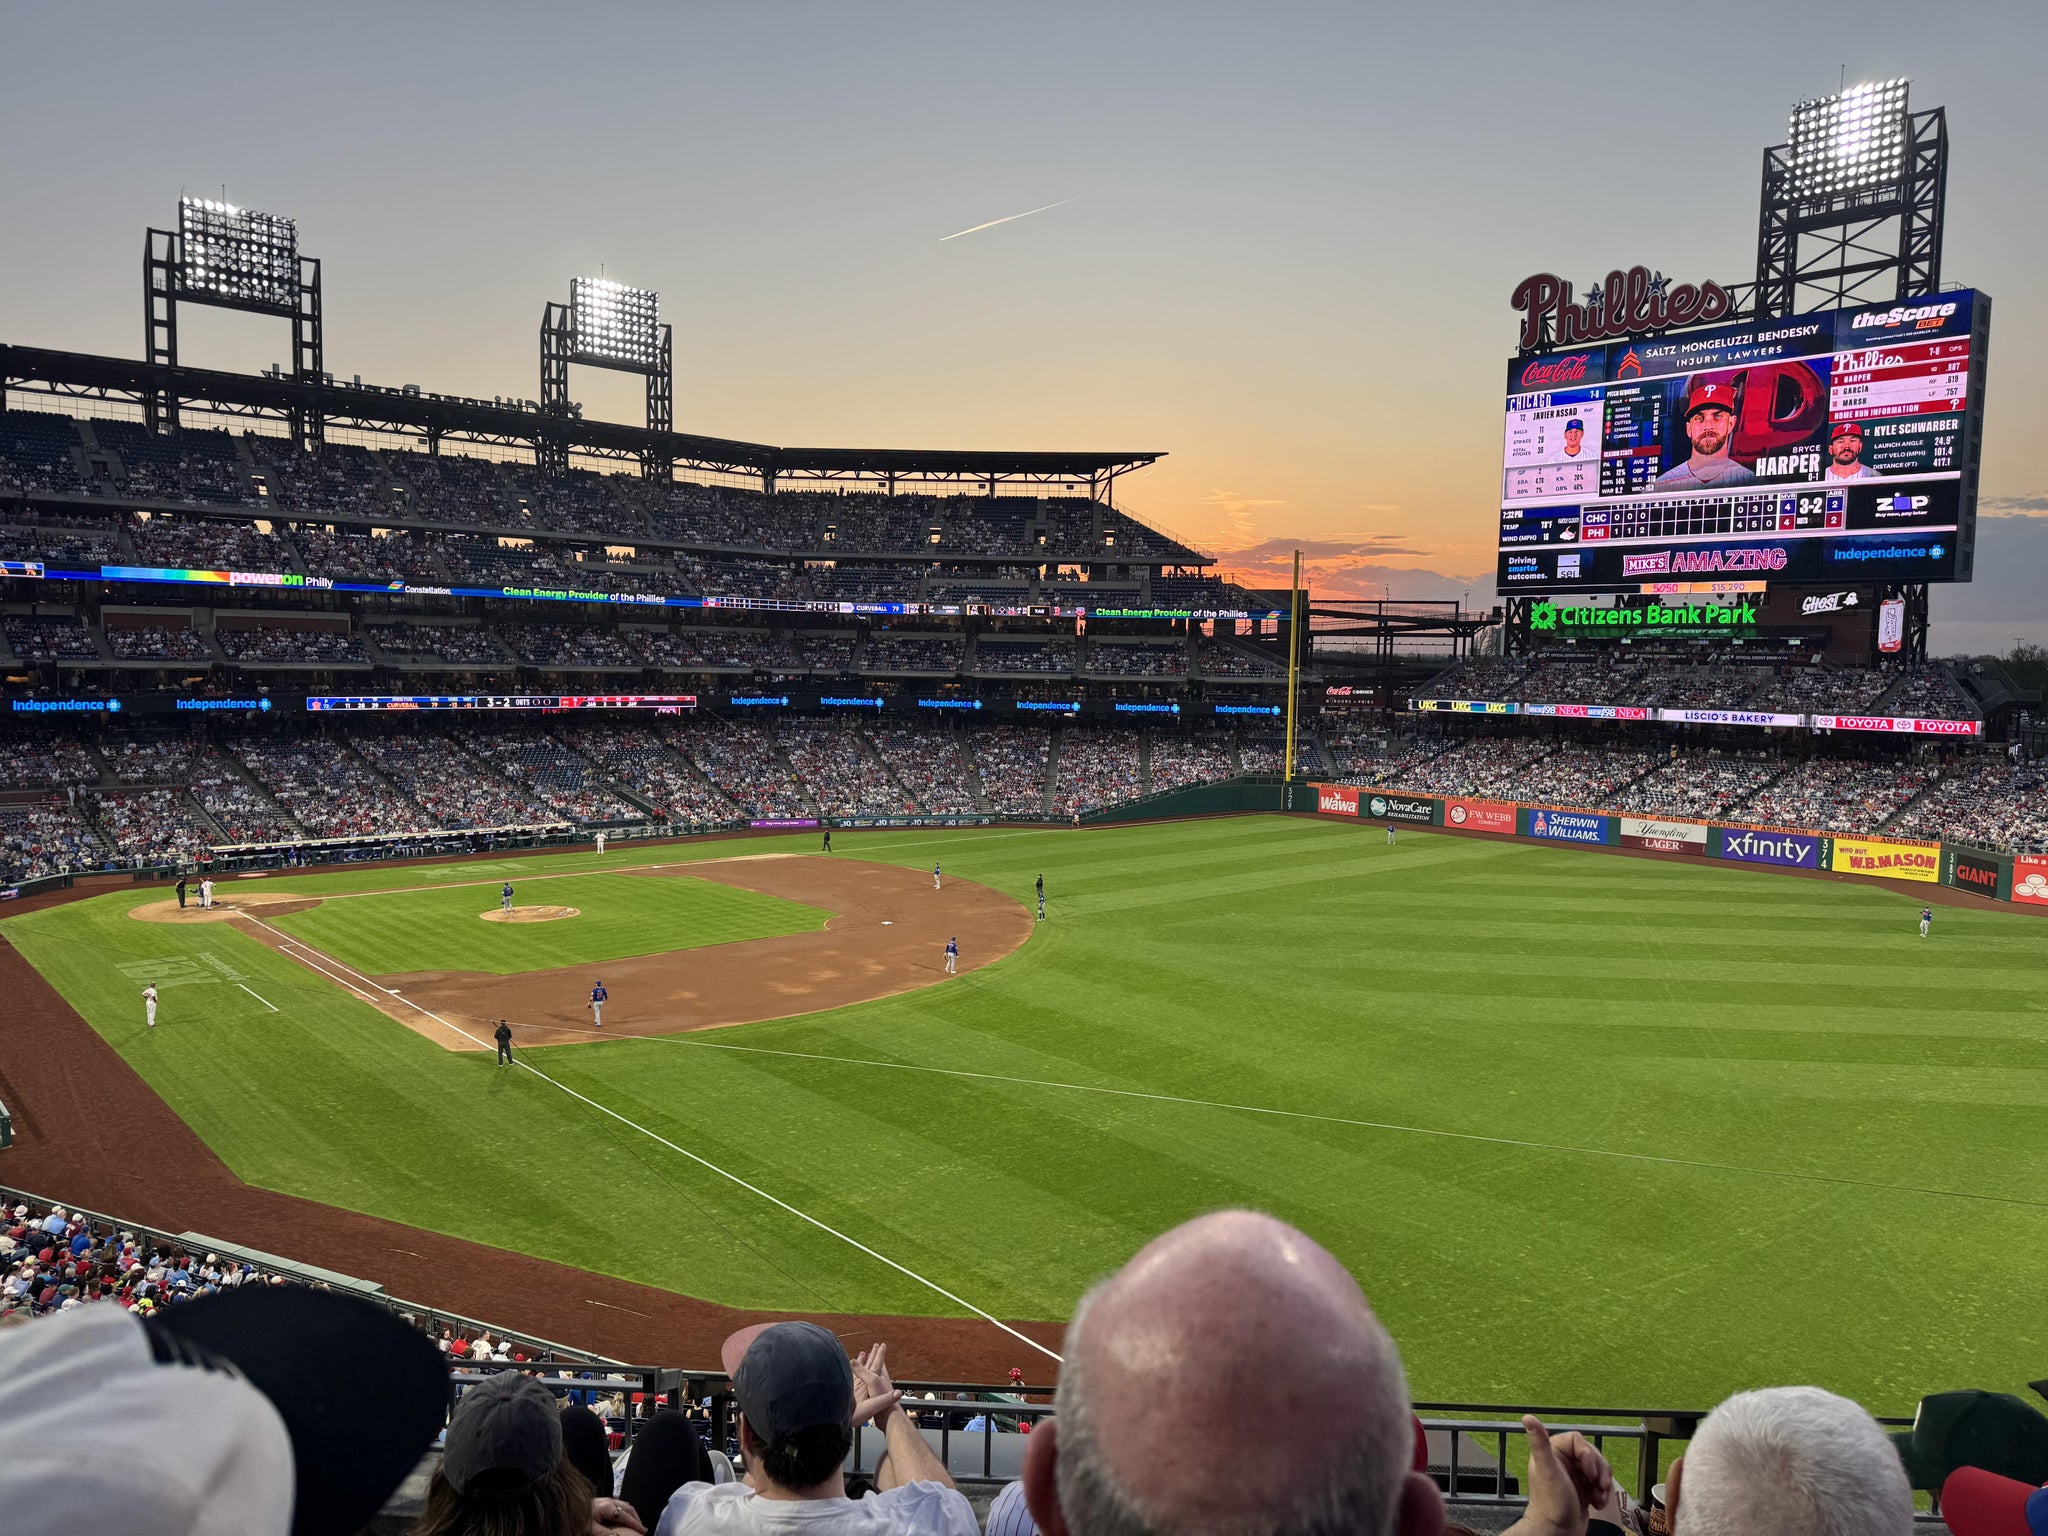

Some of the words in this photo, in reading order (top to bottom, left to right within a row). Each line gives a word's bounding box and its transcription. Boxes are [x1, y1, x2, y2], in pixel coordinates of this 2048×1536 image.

[1511, 265, 1729, 350] Phillies
[1851, 303, 1957, 329] theScore
[1646, 346, 1677, 358] SALTZ
[1682, 334, 1753, 355] MONGELUZZI
[1758, 324, 1820, 342] BENDESKY
[1676, 354, 1718, 368] INJURY
[1728, 345, 1782, 361] LAWYERS
[1833, 351, 1904, 374] Phillies
[1843, 372, 1871, 384] HARPER
[1510, 393, 1551, 412] CHICAGO
[1842, 397, 1867, 407] MARSH
[1533, 411, 1555, 421] JAVIER
[1556, 407, 1577, 418] ASSAD
[1834, 410, 1853, 421] HOME
[1854, 408, 1869, 419] RUN
[1870, 404, 1919, 417] INFORMATION
[1874, 424, 1897, 437] KYLE
[1898, 418, 1958, 436] SCHWARBER
[1792, 444, 1821, 454] BRYCE
[1874, 441, 1900, 450] LAUNCH
[1900, 439, 1924, 448] ANGLE
[1873, 453, 1886, 461] EXIT
[1887, 451, 1905, 460] VELO
[1756, 453, 1820, 478] HARPER
[1872, 462, 1904, 471] DISTANCE
[1799, 497, 1823, 515] 3-2
[1586, 513, 1607, 524] CHC
[1588, 528, 1604, 538] PHI
[1671, 547, 1787, 573] AMAZING
[1834, 547, 1926, 562] Independence
[1508, 556, 1537, 567] Driving
[1627, 556, 1666, 570] MIKE'S
[1507, 565, 1538, 573] smarter
[305, 576, 334, 589] Philly
[1507, 573, 1548, 581] outcomes.
[1711, 582, 1745, 593] $15,290
[502, 586, 532, 598] Clean
[533, 588, 567, 601] Energy
[568, 589, 609, 601] Provider
[610, 592, 620, 601] of
[620, 592, 635, 602] the
[636, 593, 666, 604] Phillies
[1801, 591, 1847, 616] GHOST
[1096, 607, 1122, 617] Clean
[1122, 608, 1153, 619] Energy
[1154, 608, 1192, 618] Provider
[1193, 609, 1203, 618] of
[1203, 609, 1217, 618] the
[1218, 609, 1248, 619] Phillies
[1561, 605, 1642, 625] Citizens
[1647, 604, 1701, 624] Bank
[1705, 602, 1756, 624] Park
[13, 699, 104, 713] Independence
[176, 698, 256, 711] Independence
[516, 699, 531, 707] OUTS
[731, 696, 780, 706] Independence
[821, 697, 874, 707] Independence
[918, 698, 972, 709] Independence
[1016, 701, 1070, 711] Independence
[1418, 700, 1437, 710] UKG
[1115, 703, 1171, 713] Independence
[1215, 705, 1270, 714] Independence
[1451, 702, 1471, 712] UKG
[1485, 703, 1506, 713] UKG
[1558, 706, 1586, 717] NECA
[1618, 708, 1646, 719] NECA
[1685, 712, 1728, 722] LISCIO'S
[1731, 714, 1775, 724] BAKERY
[1839, 718, 1889, 730] TOYOTA
[1919, 721, 1972, 734] TOYOTA
[1320, 783, 1351, 791] ASPLUNDH
[1355, 787, 1387, 795] ASPLUNDH
[1392, 790, 1425, 798] ASPLUNDH
[1431, 794, 1465, 802] ASPLUNDH
[1320, 796, 1357, 814] Wawa
[1387, 799, 1432, 814] NovaCare
[1472, 797, 1508, 806] ASPLUNDH
[1514, 801, 1552, 811] ASPLUNDH
[1386, 811, 1430, 821] REHABILITATION
[1469, 810, 1486, 819] F.W.
[1487, 812, 1512, 822] WEBB
[1559, 805, 1599, 816] ASPLUNDH
[1606, 810, 1648, 820] ASPLUNDH
[1477, 819, 1502, 827] COMPANY
[1549, 812, 1599, 829] SHERWIN
[1655, 815, 1698, 825] ASPLUNDH
[1707, 820, 1752, 831] ASPLUNDH
[1636, 821, 1691, 840] Yuengling
[1761, 825, 1808, 836] ASPLUNDH
[1818, 830, 1868, 842] ASPLUNDH
[1644, 839, 1680, 852] LAGER
[1727, 832, 1811, 864] xfinity
[1880, 838, 1933, 848] ASPLUNDH
[1839, 847, 1853, 855] WHO
[1854, 848, 1867, 856] BUT
[2020, 855, 2039, 866] Like
[1956, 865, 1997, 888] GIANT
